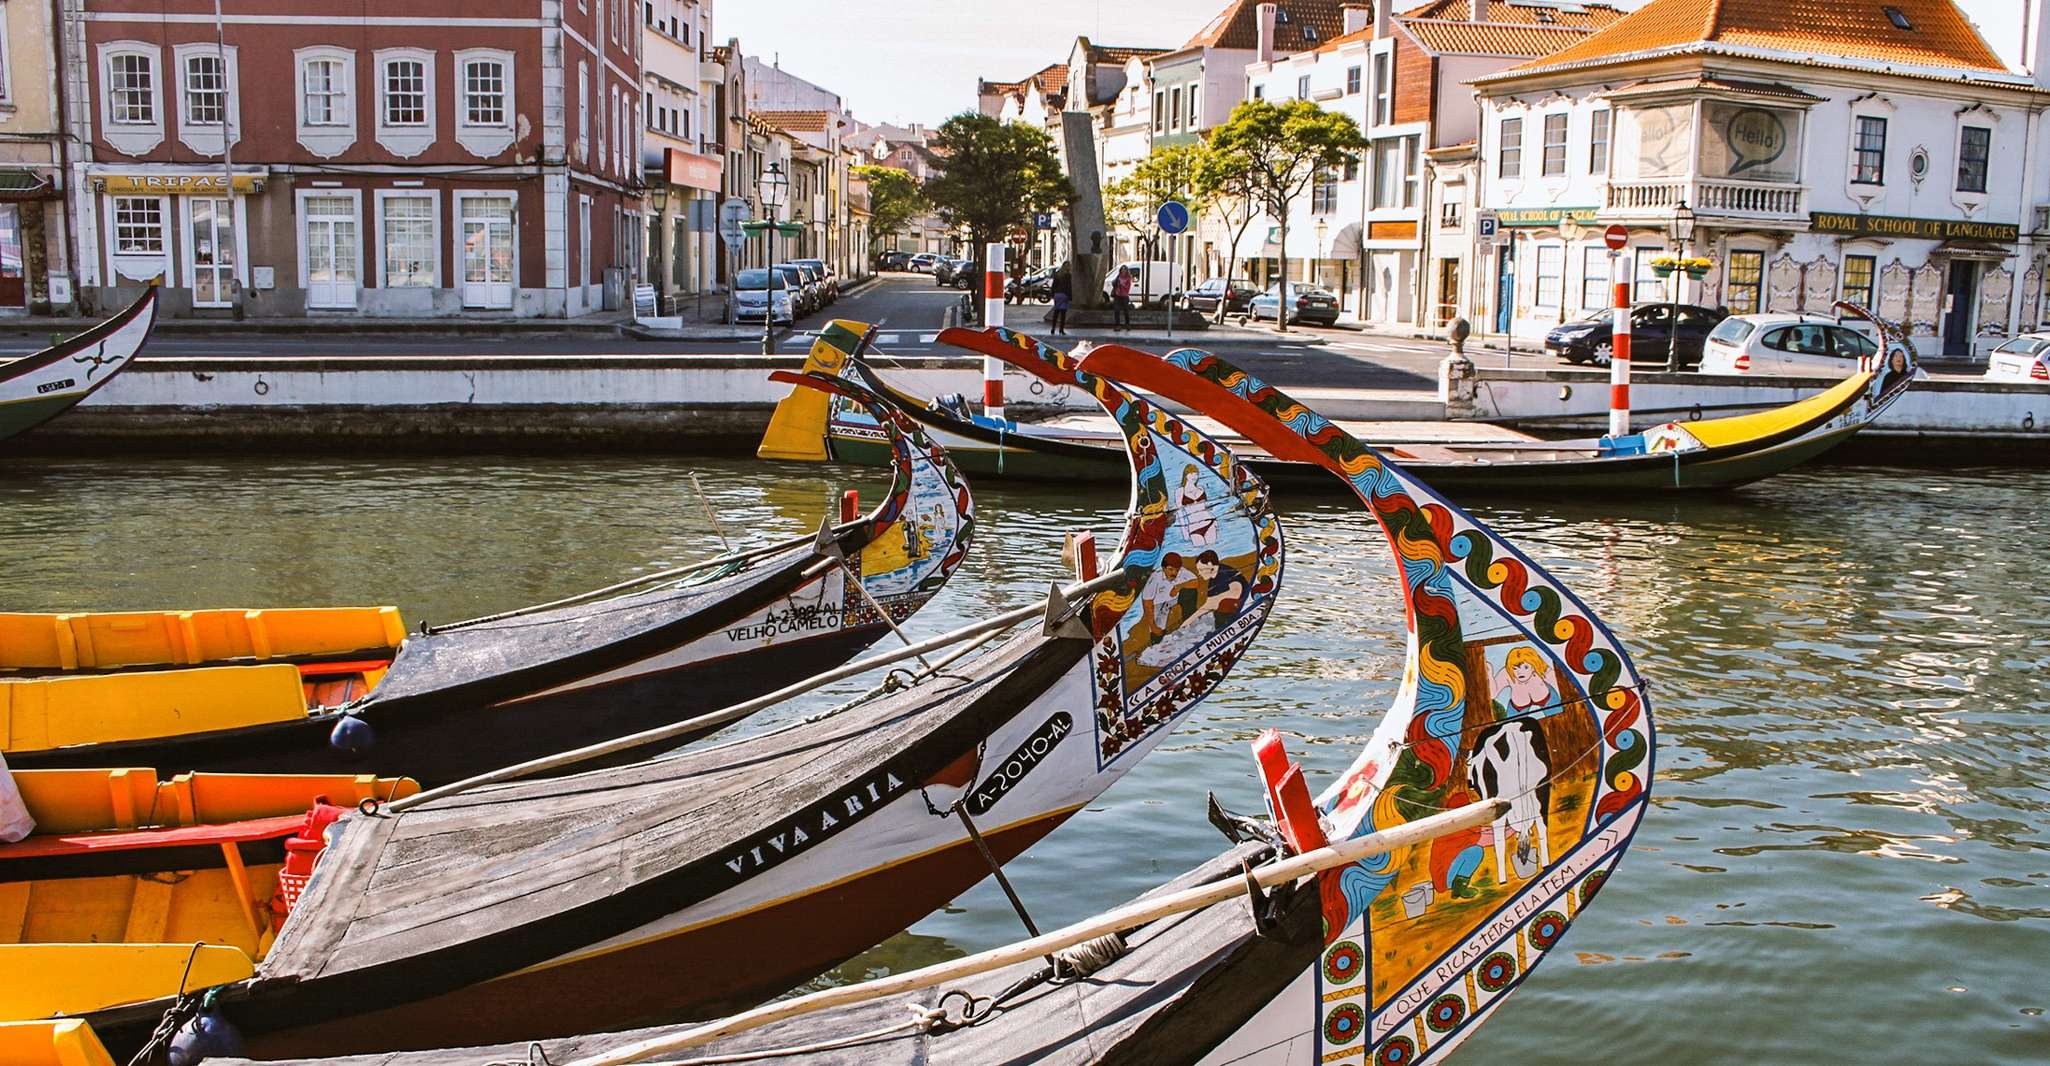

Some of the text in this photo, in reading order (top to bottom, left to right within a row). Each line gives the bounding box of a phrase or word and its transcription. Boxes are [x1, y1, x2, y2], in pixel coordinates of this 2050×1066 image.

[1734, 123, 1778, 150] Hello!
[127, 176, 229, 187] TRIPAS
[1482, 220, 1492, 234] P
[1818, 214, 2016, 241] ROYAL SCHOOL OF LANGUAGES
[727, 615, 839, 642] VELHO CAMELO
[1207, 627, 1236, 652] MUITO
[977, 718, 1072, 808] A-2040-AL
[725, 824, 809, 875] VIVA
[1396, 980, 1438, 1014] QUE
[1436, 944, 1481, 983] RICAS
[1479, 916, 1514, 947] TETAS
[1516, 893, 1541, 919] ELA
